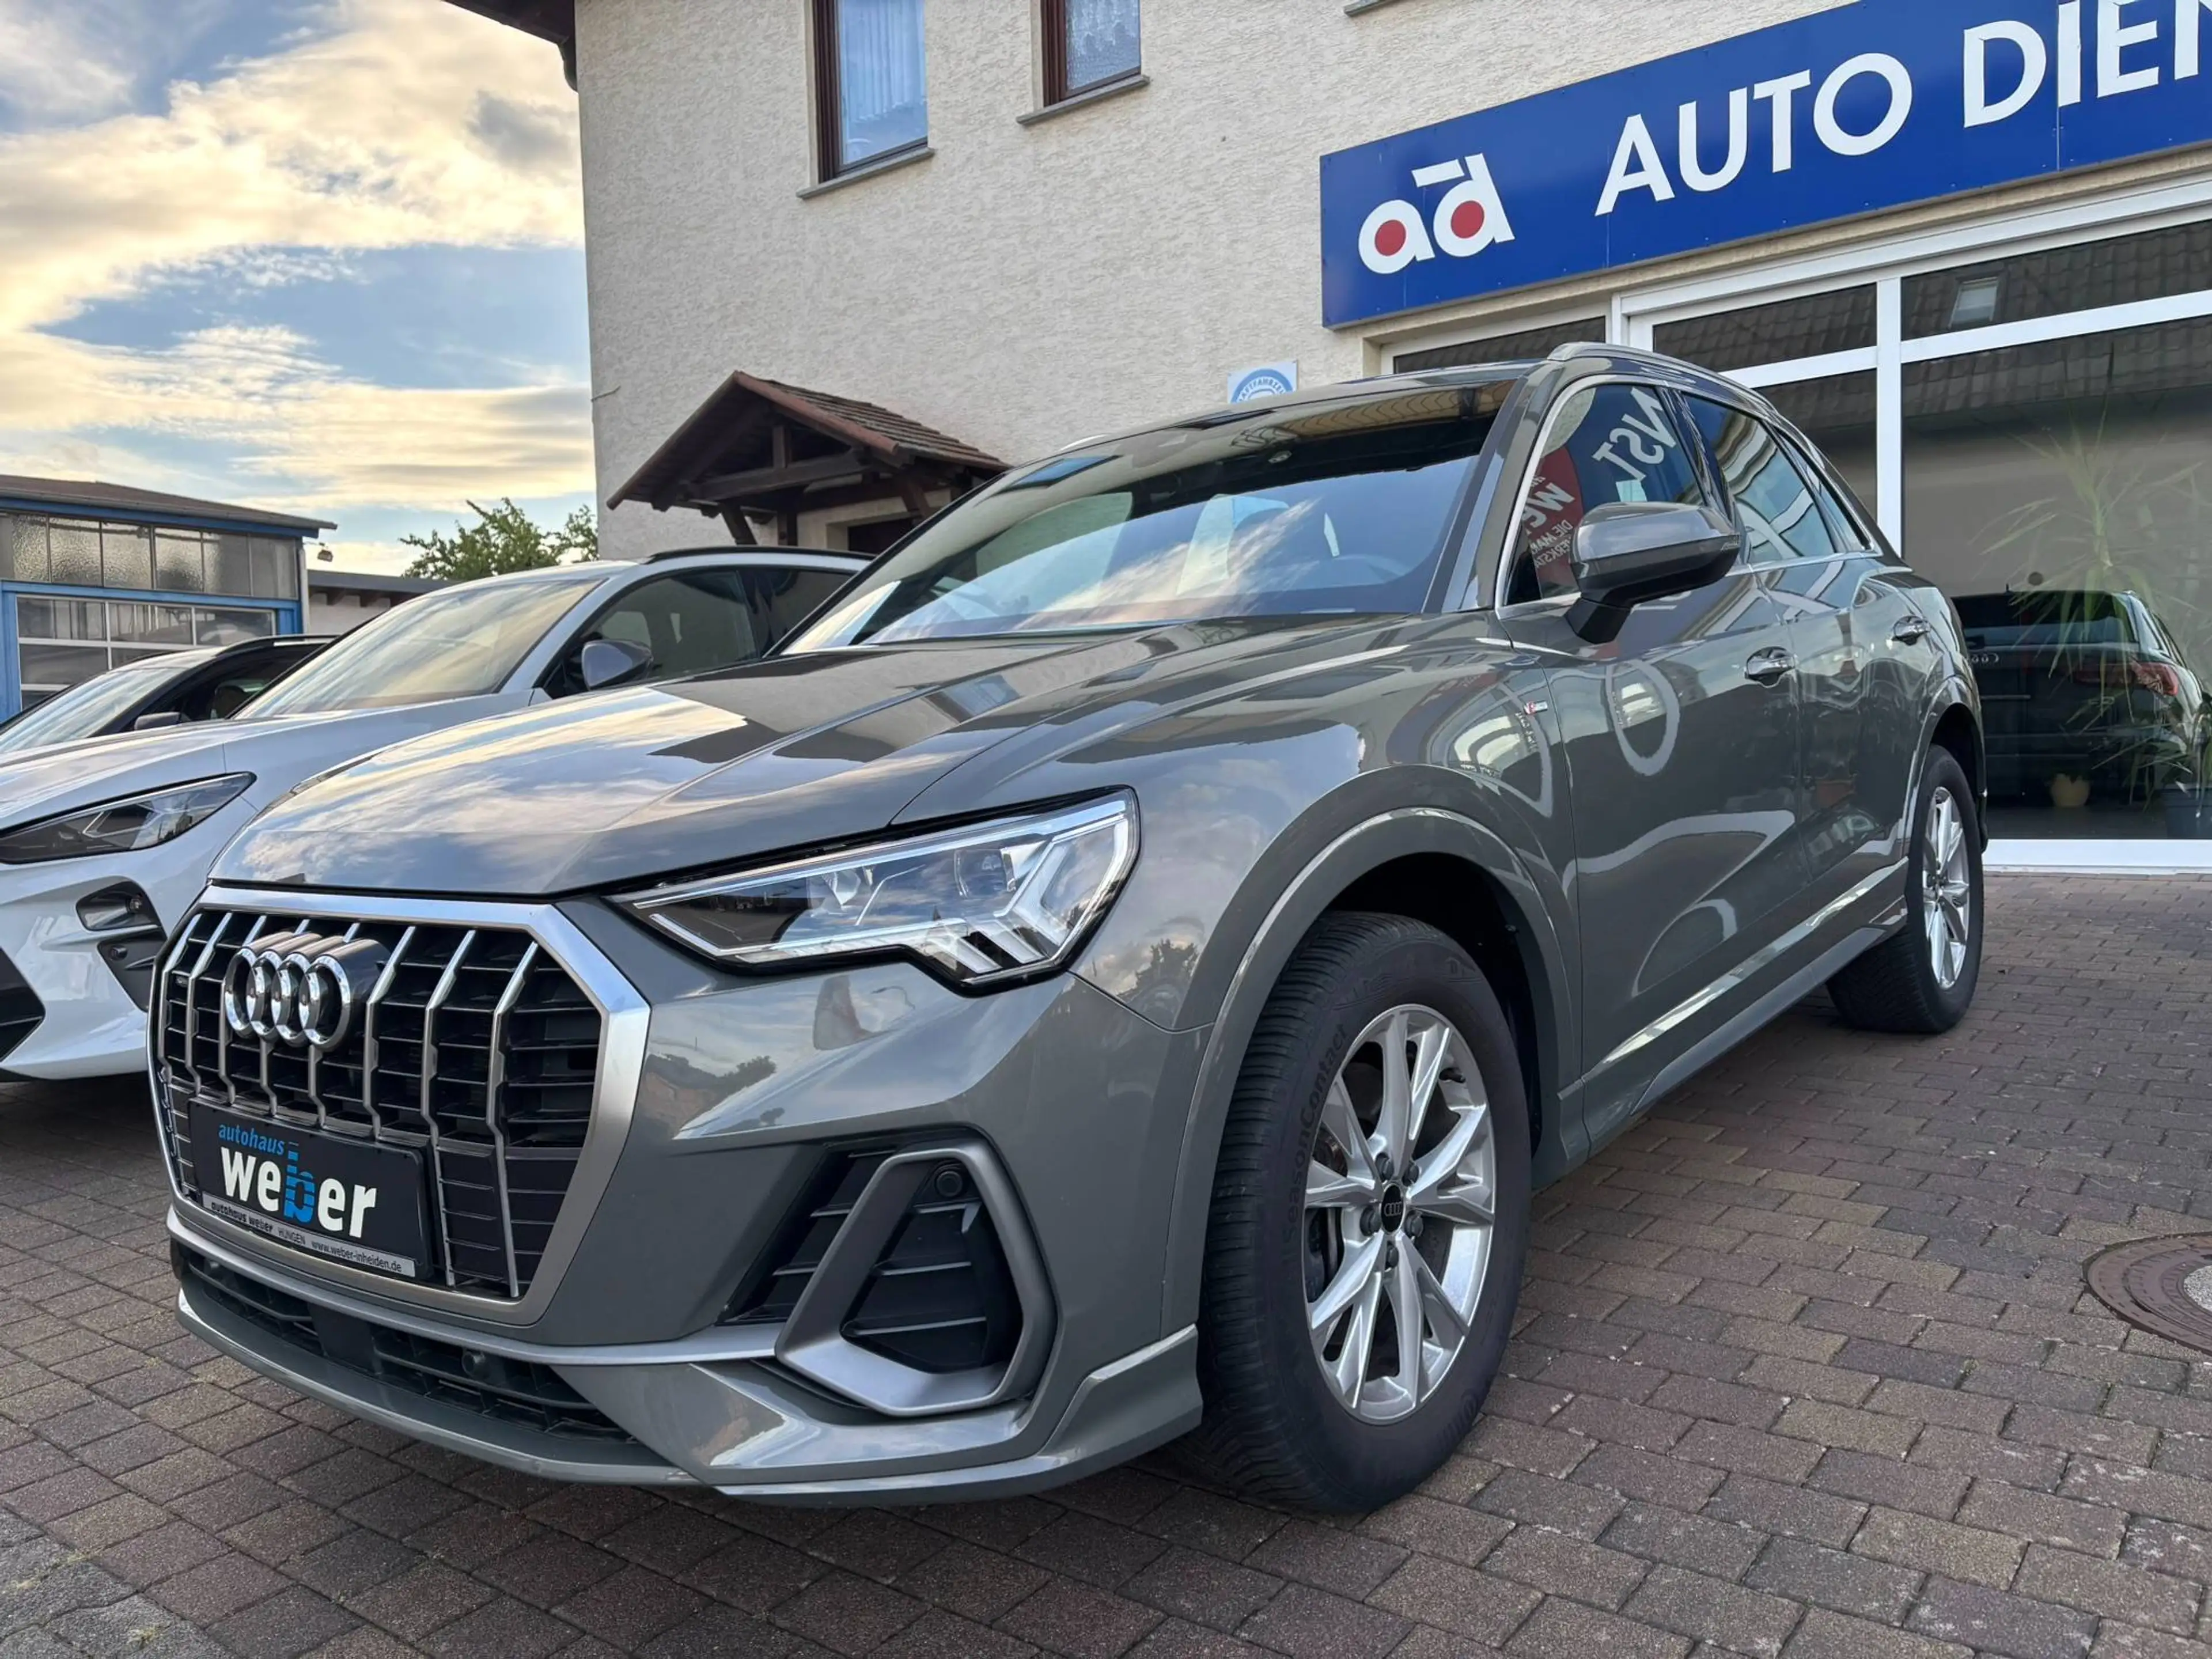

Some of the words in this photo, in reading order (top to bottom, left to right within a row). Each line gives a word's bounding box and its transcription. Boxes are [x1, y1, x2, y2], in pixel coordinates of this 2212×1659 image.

[1595, 53, 1912, 217] AUTO
[218, 1124, 285, 1156] autohaus
[211, 1202, 248, 1222] autohaus
[248, 1216, 273, 1232] weber
[221, 1142, 377, 1238] weber
